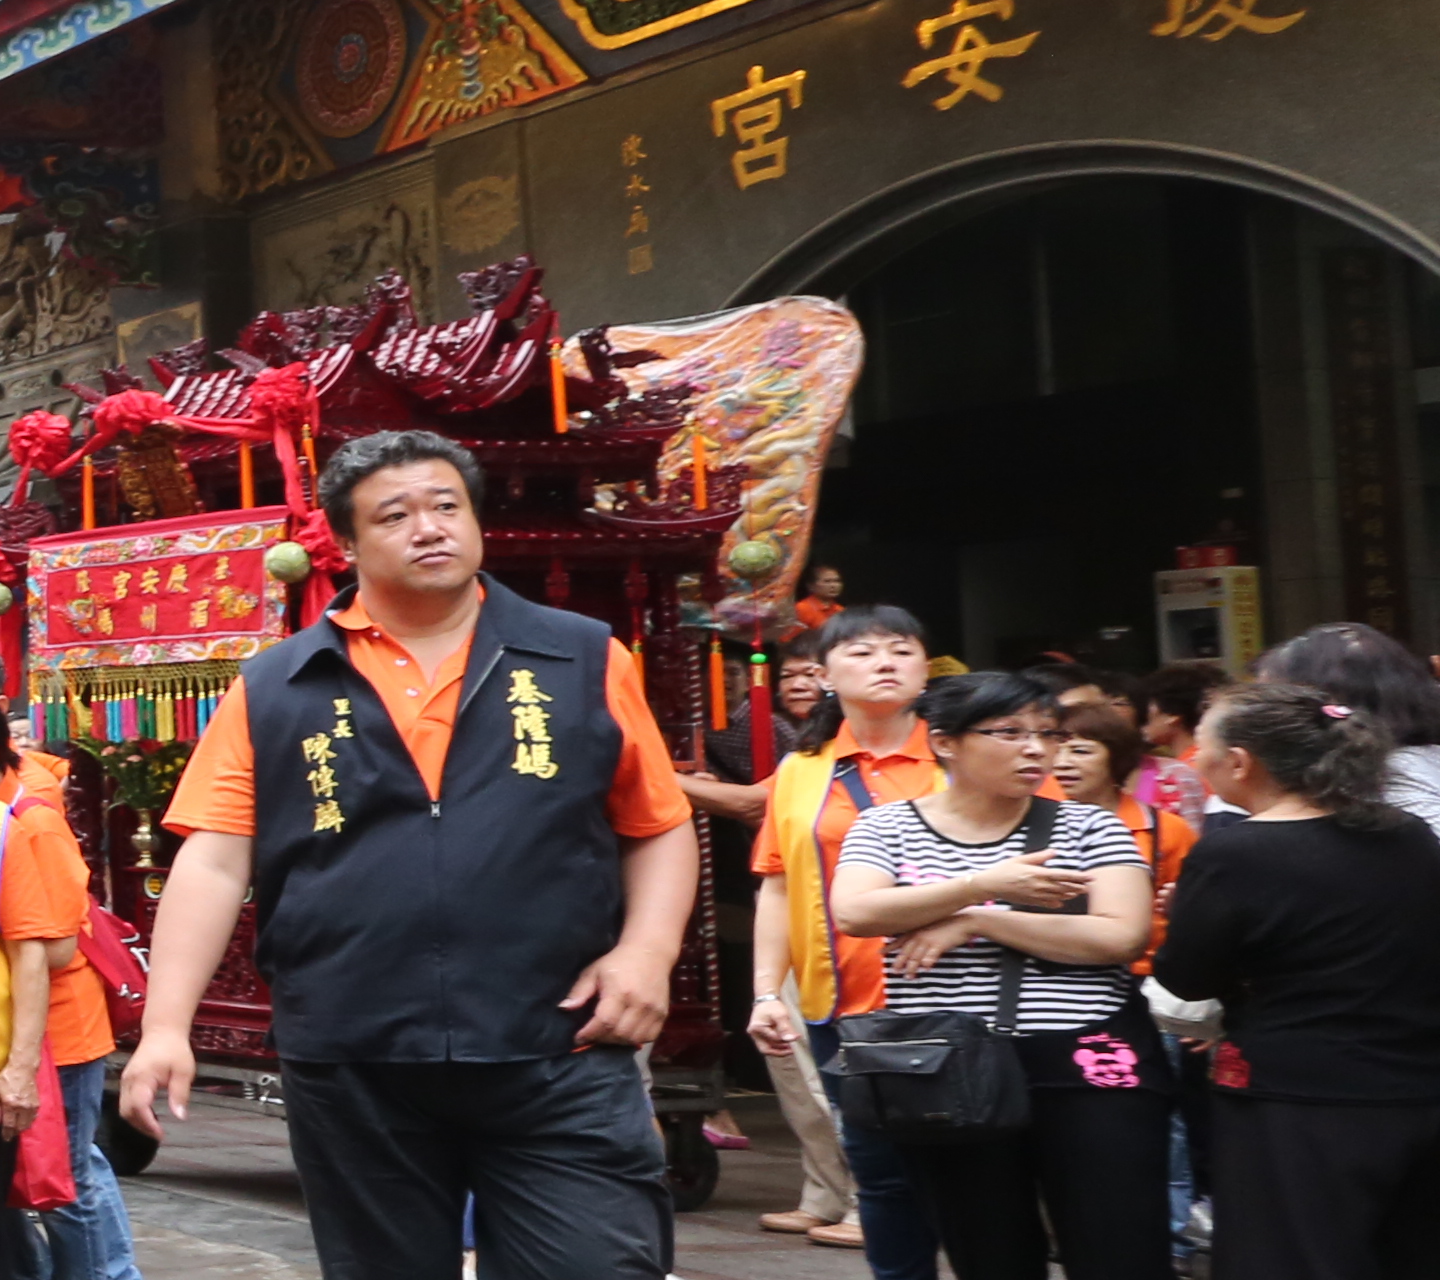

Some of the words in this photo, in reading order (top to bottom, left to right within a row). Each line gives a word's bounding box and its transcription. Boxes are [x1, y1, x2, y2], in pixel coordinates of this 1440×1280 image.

[332, 697, 355, 739] 里長
[506, 668, 559, 780] 基隆媽
